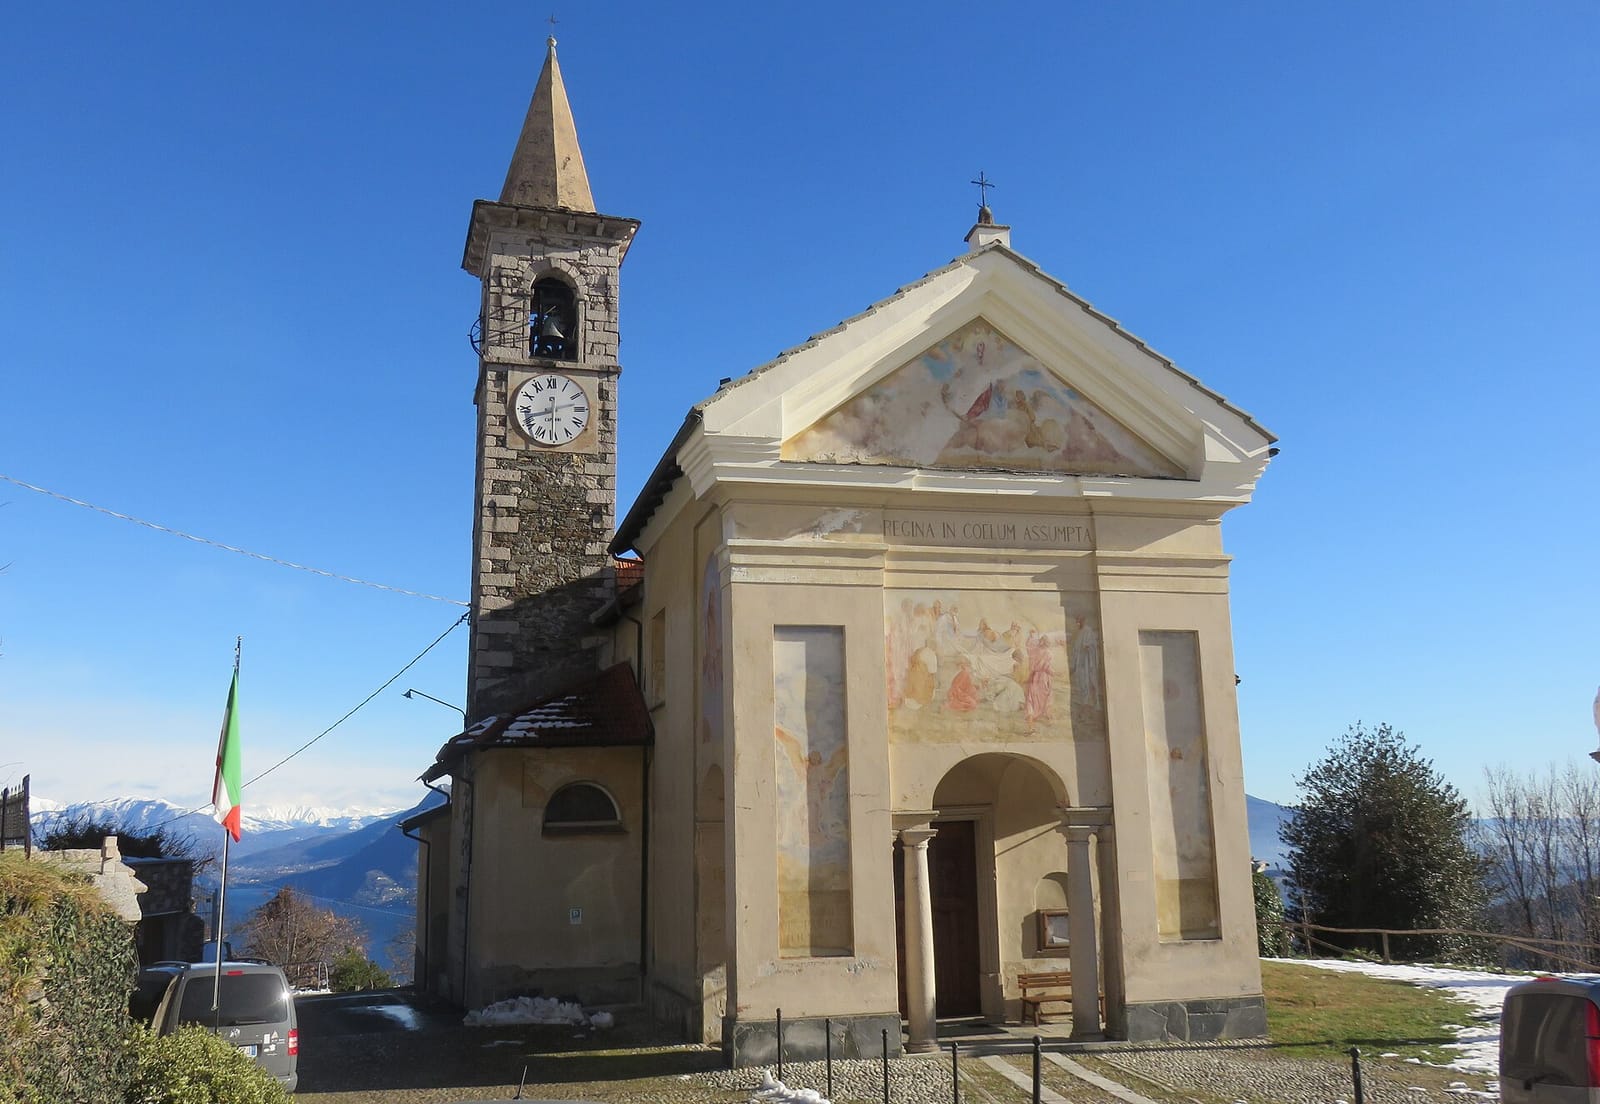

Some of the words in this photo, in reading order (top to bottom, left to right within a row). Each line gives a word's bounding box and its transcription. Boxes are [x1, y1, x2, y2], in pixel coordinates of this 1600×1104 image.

[532, 380, 543, 393] XI
[547, 378, 557, 389] XII
[562, 382, 568, 392] I
[523, 391, 535, 401] X
[570, 392, 582, 401] II
[572, 417, 583, 428] IV
[535, 426, 546, 438] VII
[564, 428, 572, 437] V
[883, 519, 935, 538] REGINA
[942, 521, 956, 539] IN
[963, 522, 1016, 541] COELUM
[1023, 525, 1092, 542] ASSUMPTA
